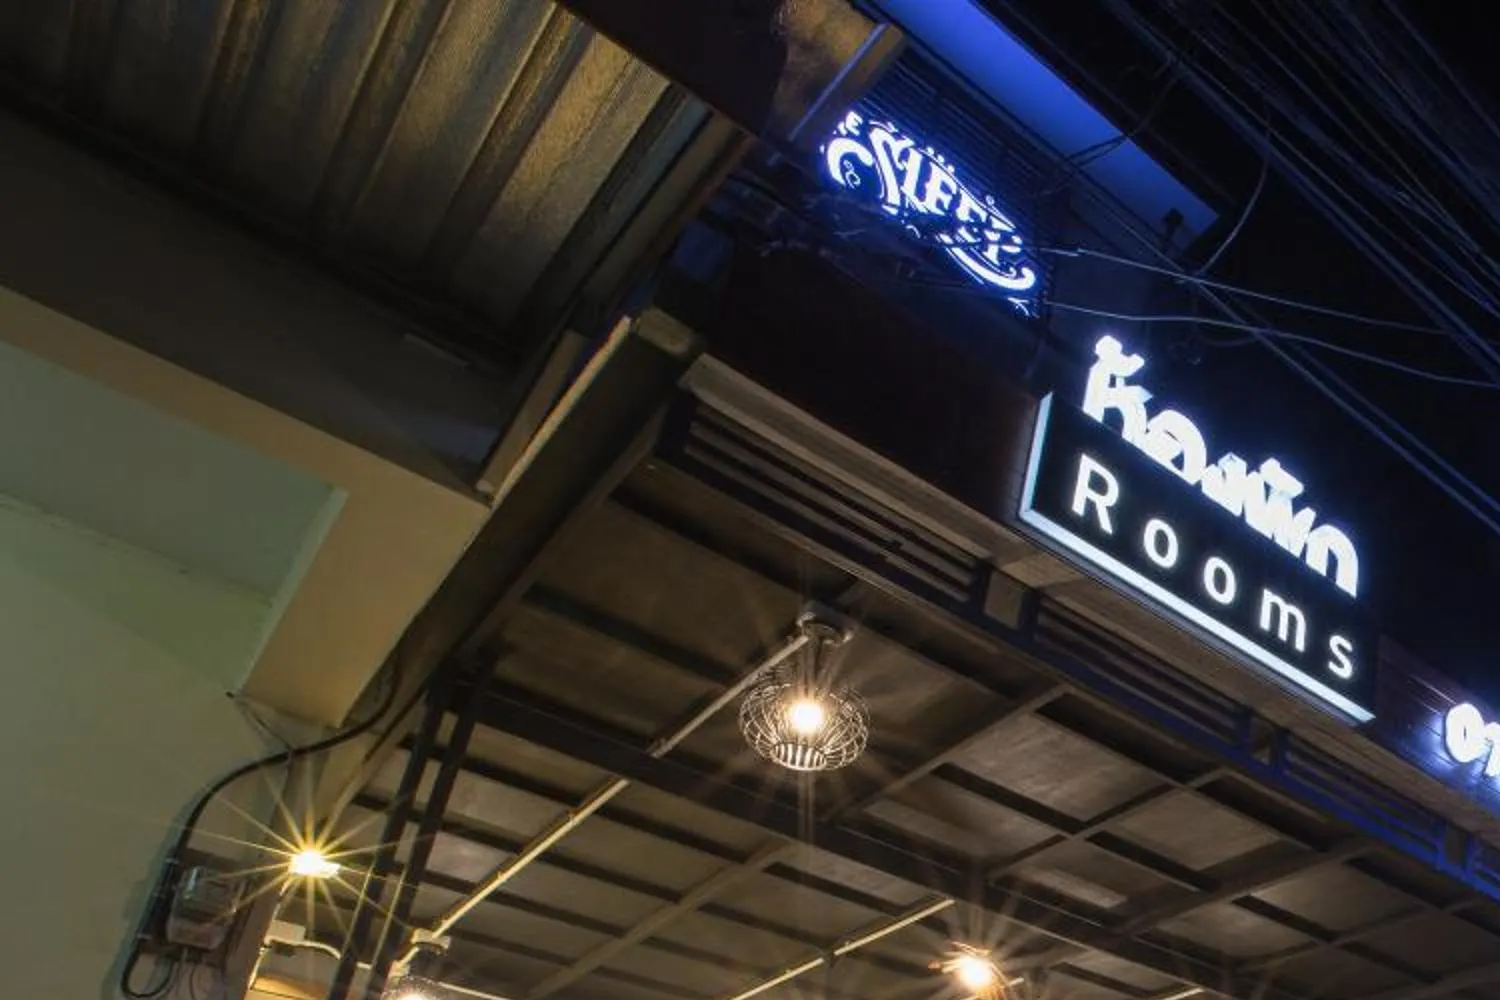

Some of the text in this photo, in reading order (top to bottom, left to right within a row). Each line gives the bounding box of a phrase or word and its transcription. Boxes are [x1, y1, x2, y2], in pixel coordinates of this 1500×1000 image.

[1071, 452, 1354, 680] Rooms
[1083, 335, 1359, 598] ห้องพัก
